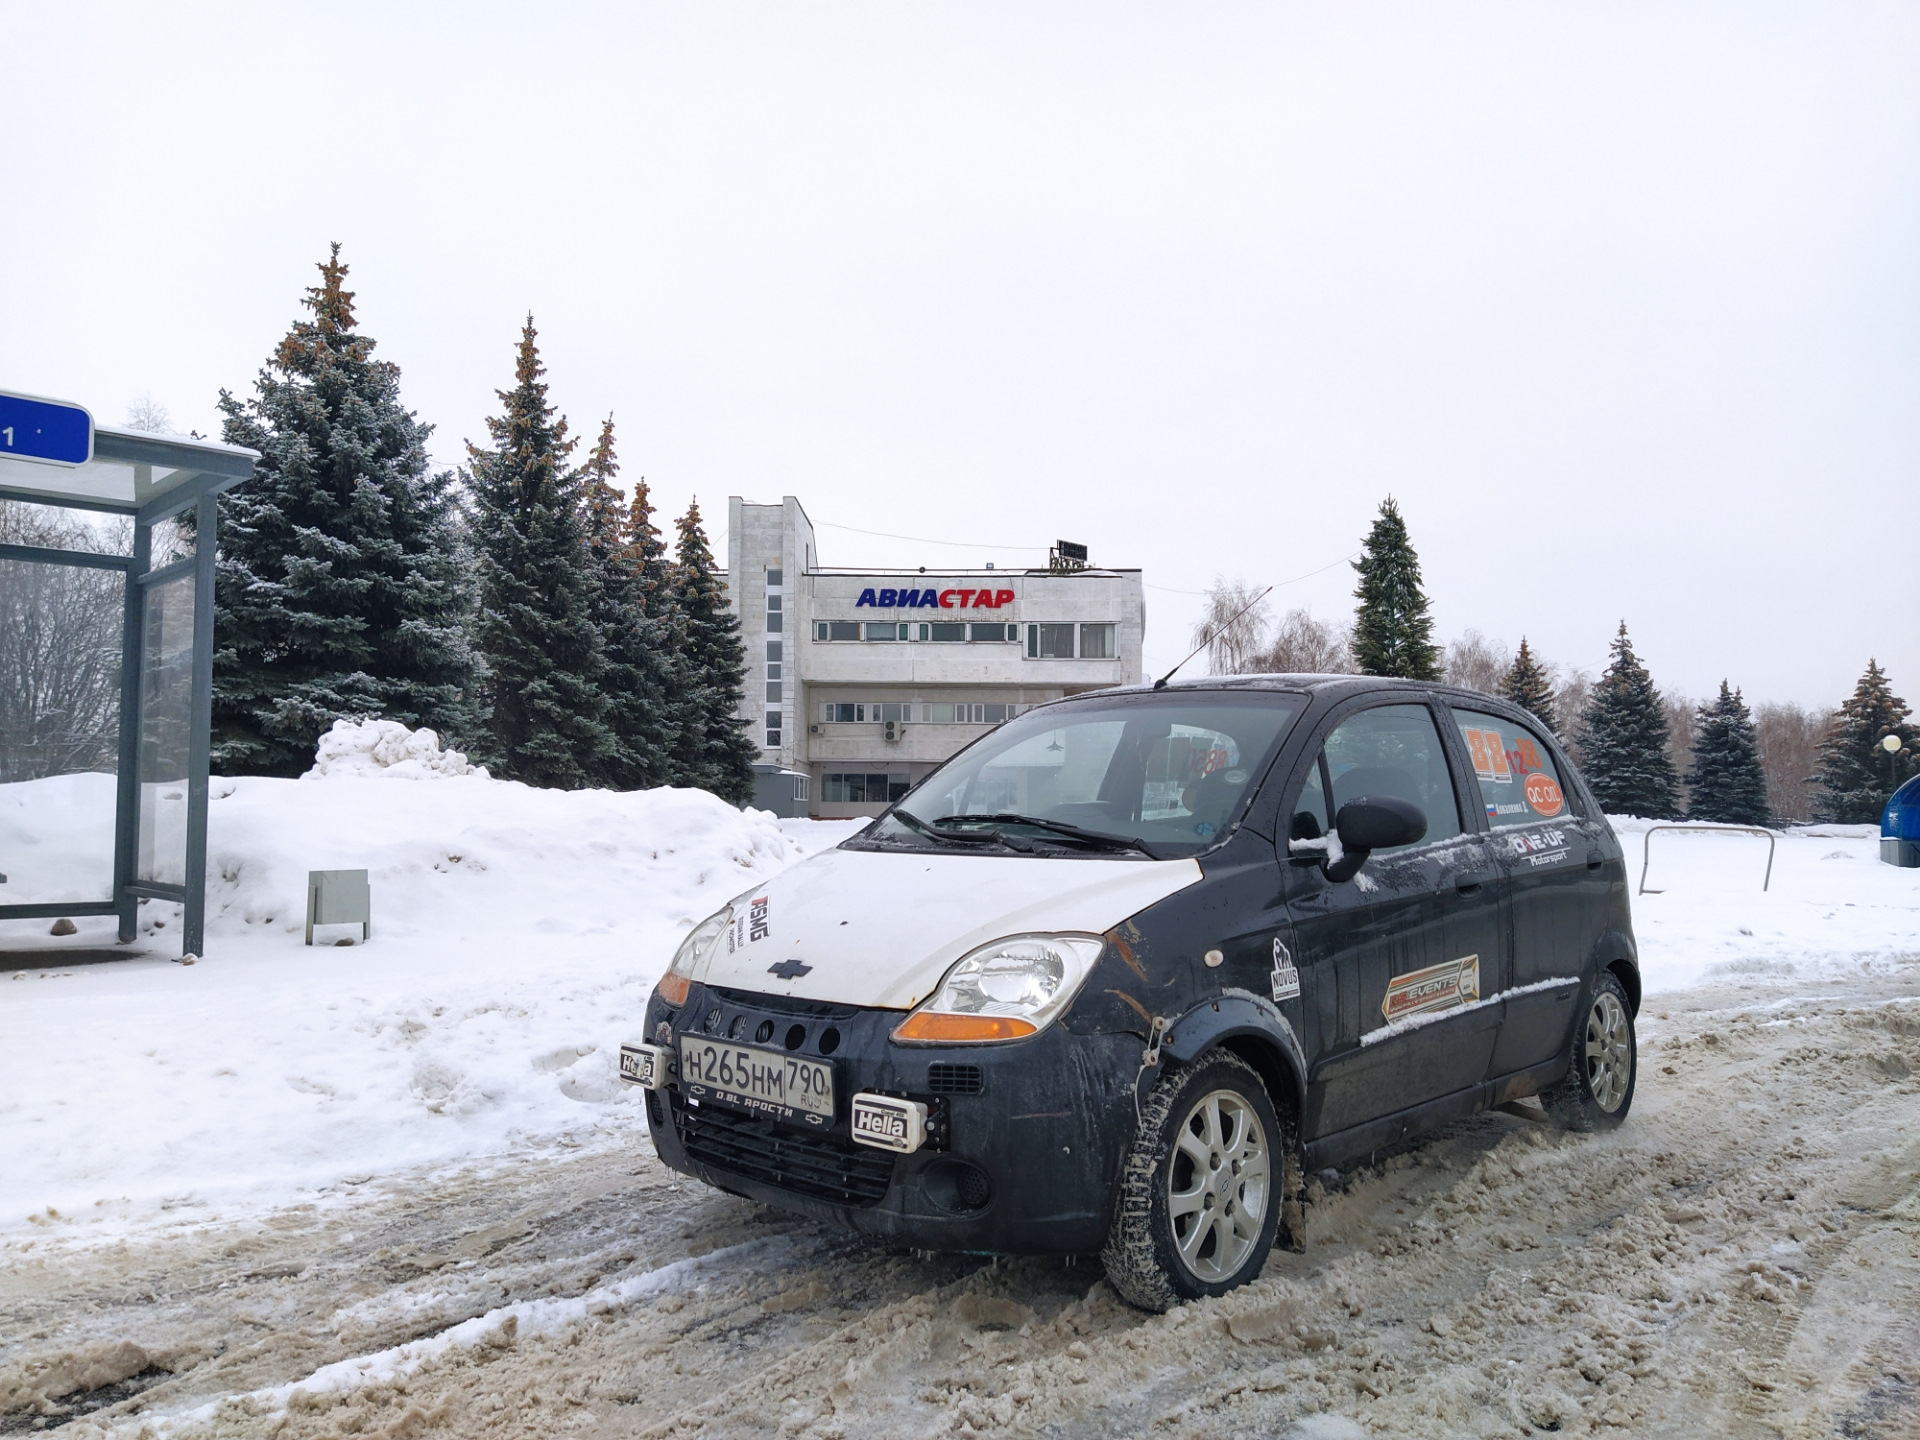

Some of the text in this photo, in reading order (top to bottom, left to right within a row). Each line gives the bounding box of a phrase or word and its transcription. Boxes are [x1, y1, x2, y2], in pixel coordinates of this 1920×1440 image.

[2, 426, 14, 447] 1
[855, 588, 1015, 609] АВИАСТАР
[1527, 786, 1561, 803] QC OIL
[1530, 850, 1567, 867] Motorsport
[750, 895, 770, 943] ASMG
[1273, 969, 1298, 988] NOVUS
[1409, 976, 1458, 999] EVENTS
[787, 1061, 826, 1095] 790
[744, 1098, 793, 1117] ЯРОСТИ
[858, 1111, 904, 1136] Hella
